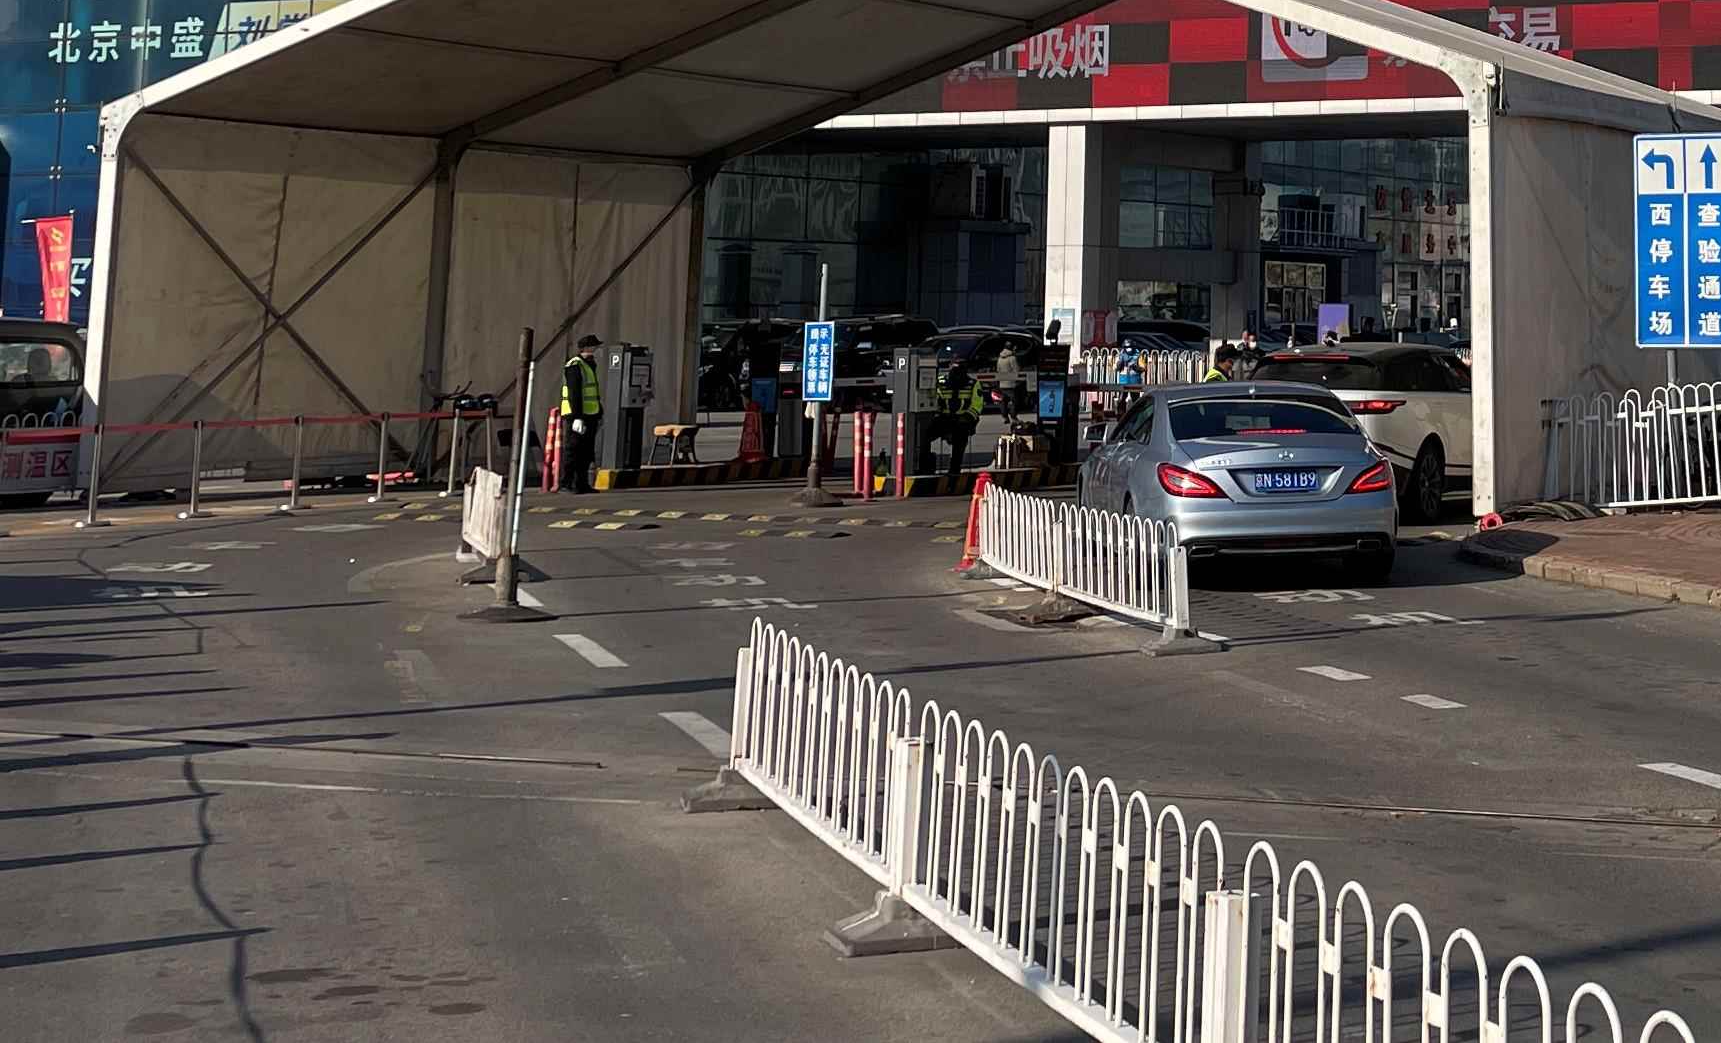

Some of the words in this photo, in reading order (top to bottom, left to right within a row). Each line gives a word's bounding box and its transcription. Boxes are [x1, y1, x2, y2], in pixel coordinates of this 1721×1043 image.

[48, 16, 205, 64] 北京中盛
[1648, 203, 1673, 336] 西停车场
[1697, 203, 1721, 336] 查验通道
